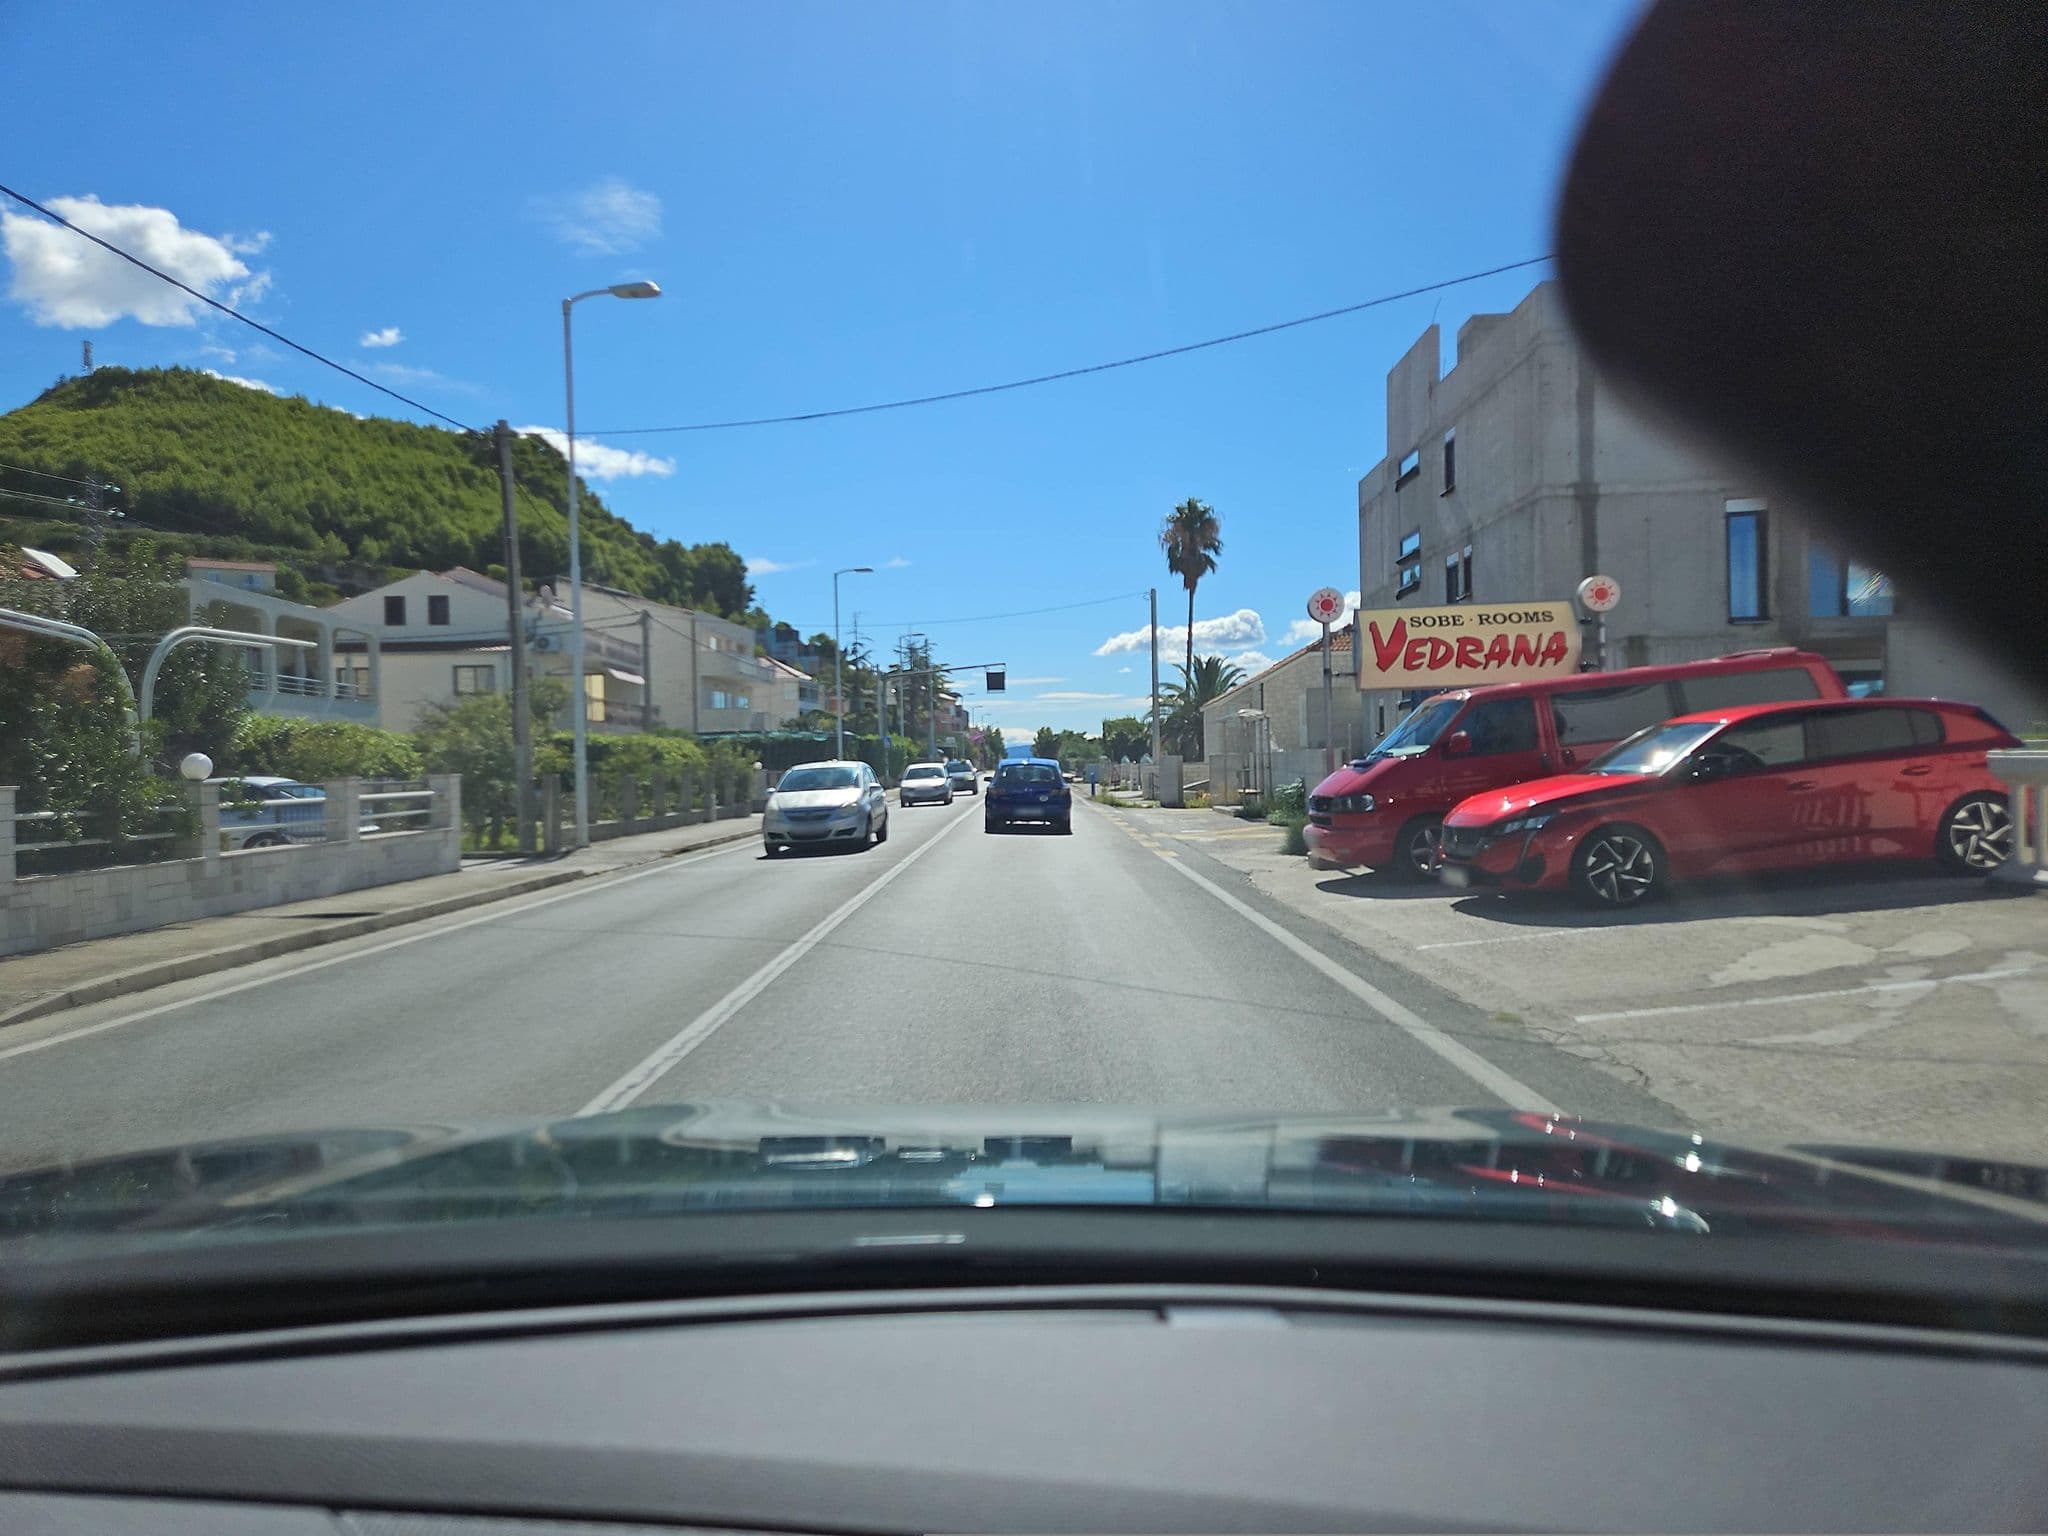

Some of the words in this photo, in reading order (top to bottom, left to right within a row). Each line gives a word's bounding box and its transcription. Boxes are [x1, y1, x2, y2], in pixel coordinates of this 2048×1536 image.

[1410, 615, 1465, 628] SOBE
[1478, 610, 1554, 625] ROOMS
[1369, 617, 1568, 672] VEDRANA
